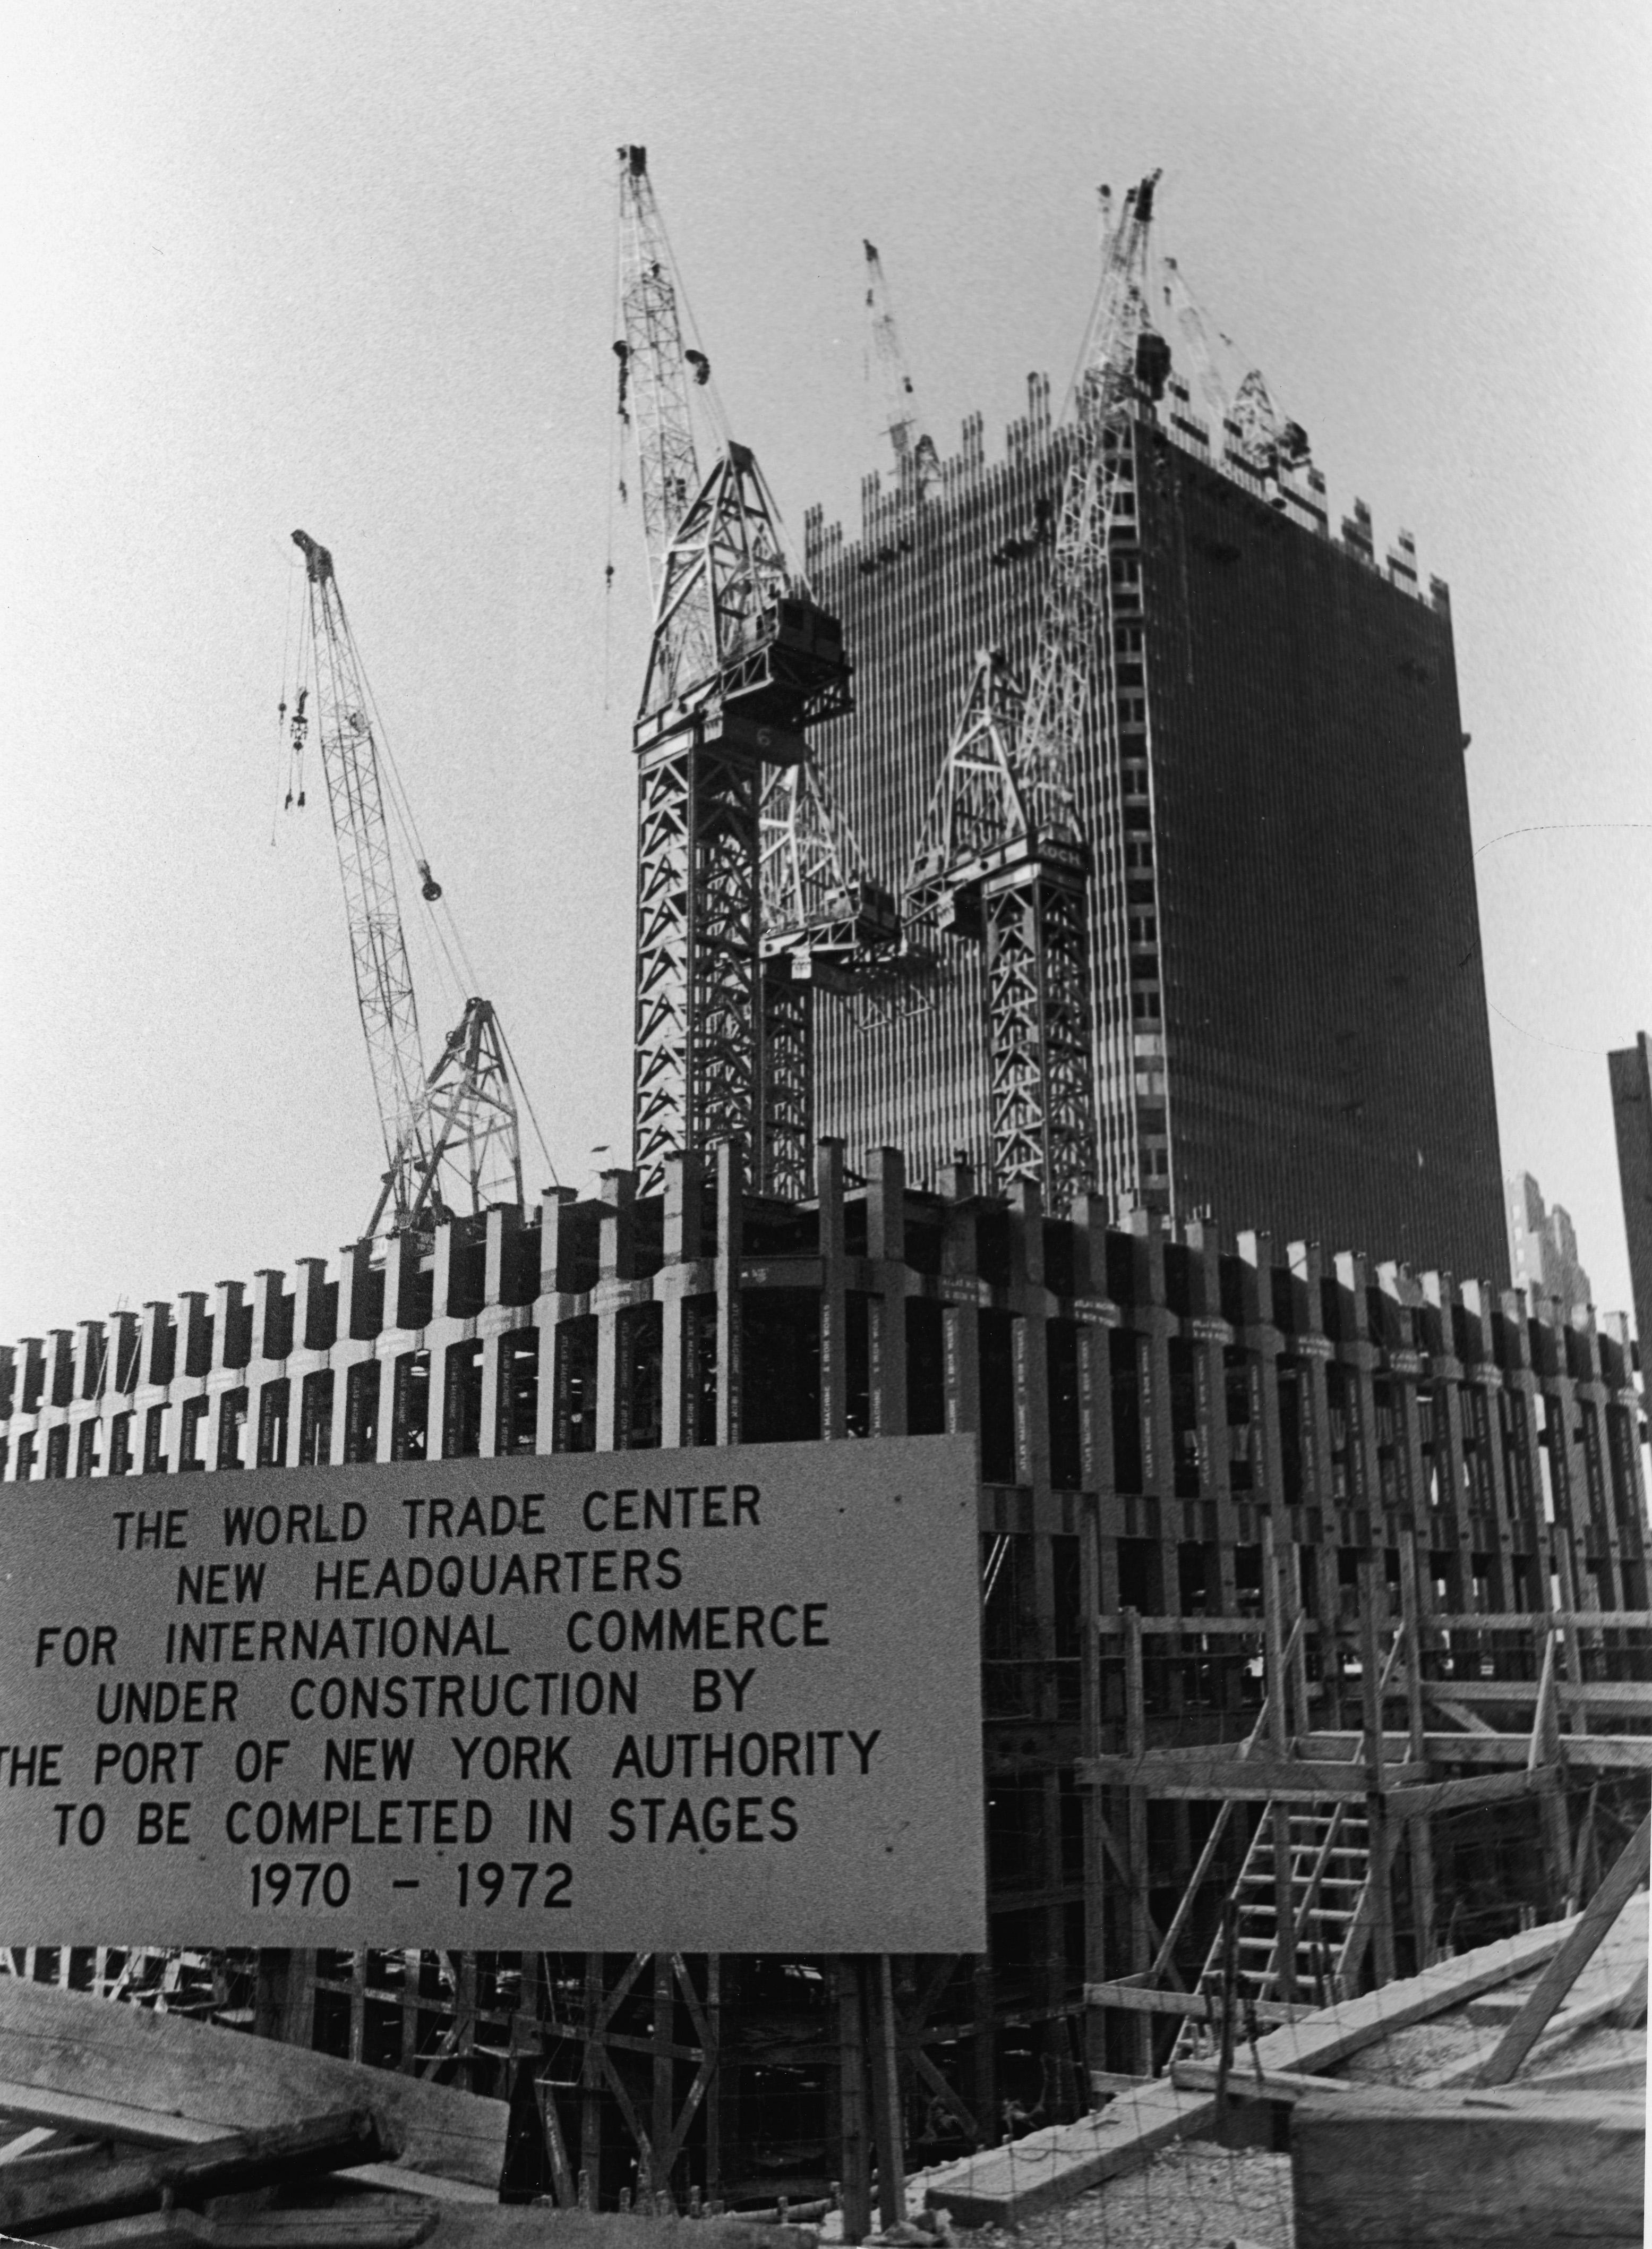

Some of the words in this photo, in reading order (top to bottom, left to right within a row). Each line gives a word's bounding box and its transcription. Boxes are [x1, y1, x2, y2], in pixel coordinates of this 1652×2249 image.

[756, 727, 770, 746] 6
[1038, 843, 1081, 866] KOCH
[112, 1509, 189, 1551] THE
[222, 1501, 368, 1547] WORLD
[401, 1492, 546, 1540] TRADE
[582, 1484, 761, 1533] CENTER
[176, 1562, 267, 1605] NEW
[314, 1547, 683, 1601] HEADQUARTERS
[35, 1625, 118, 1668] FOR
[165, 1613, 511, 1665] INTERNATIONAL
[566, 1602, 831, 1654] COMMERCE
[96, 1680, 239, 1725] UNDER
[290, 1669, 639, 1721] CONSTRUCTION
[692, 1667, 757, 1714] BY
[94, 1739, 204, 1786] PORT
[235, 1739, 291, 1784] OF
[323, 1737, 415, 1782] NEW
[450, 1735, 573, 1781] YORK
[611, 1729, 882, 1780] AUTHORITY
[53, 1802, 106, 1846] TO
[137, 1801, 192, 1845] BE
[225, 1798, 493, 1846] COMPLETED
[527, 1798, 574, 1844] IN
[607, 1795, 799, 1845] STAGES
[250, 1861, 351, 1909] 1970
[457, 1861, 574, 1910] 1972
